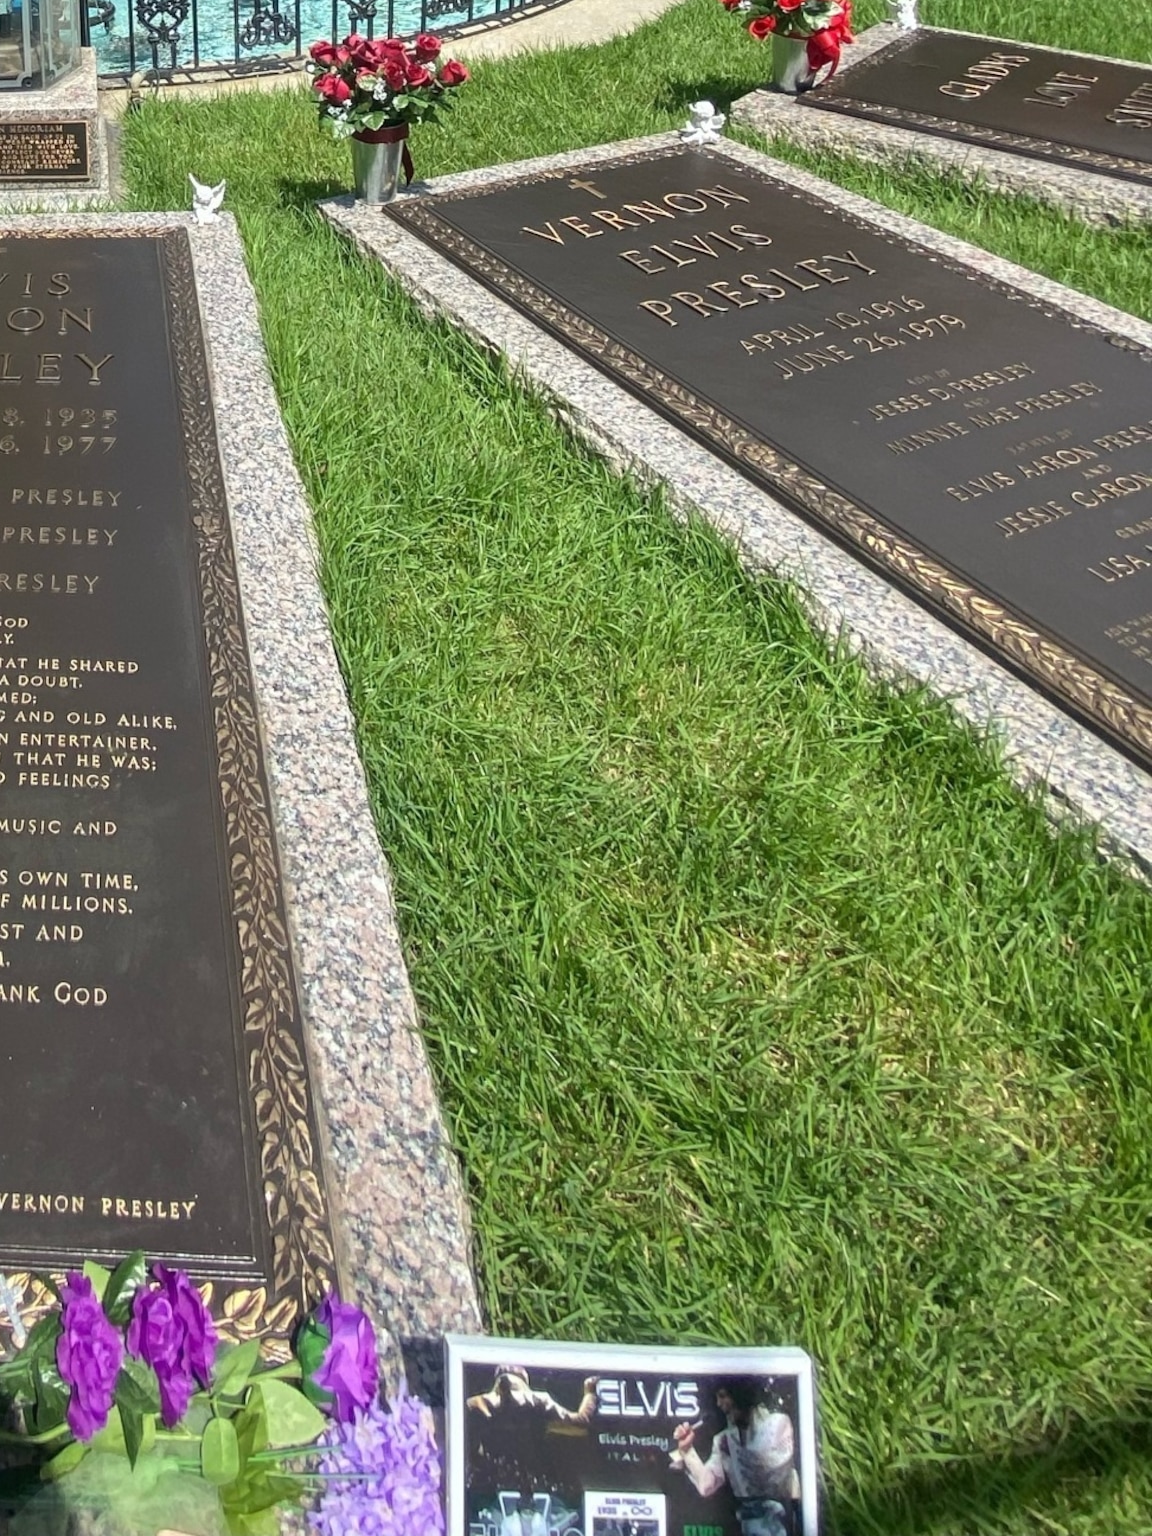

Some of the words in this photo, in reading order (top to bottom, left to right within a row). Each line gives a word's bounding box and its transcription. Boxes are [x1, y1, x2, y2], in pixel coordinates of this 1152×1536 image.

[939, 52, 1030, 100] GLADYS
[1023, 71, 1099, 108] LOVE
[521, 184, 750, 246] VERNON
[618, 224, 772, 275] ELVIS
[638, 250, 876, 327] PRESLEY
[740, 323, 824, 356] APRIL
[774, 344, 855, 381] JUNE
[43, 407, 118, 429] 1935
[867, 393, 932, 422] JESSE
[886, 420, 969, 457] MINNIE
[969, 405, 1020, 430] MAE
[1015, 380, 1103, 415] PRESLEY
[42, 434, 118, 456] 1977
[946, 471, 1015, 502] ELVIS
[1017, 444, 1098, 479] AARON
[11, 488, 122, 507] PRESLEY
[995, 500, 1072, 539] JESSIE
[2, 526, 118, 546] PRESLEY
[1087, 554, 1152, 583] LISA
[14, 711, 55, 723] AND
[66, 712, 107, 725] OLD
[14, 752, 66, 766] THAT
[77, 754, 101, 768] HE
[19, 772, 110, 789] FEELINGS
[73, 821, 117, 836] AND
[18, 871, 69, 887] OWN
[101, 1197, 196, 1221] PRESLEY
[595, 1377, 701, 1418] ELVIS
[598, 1433, 627, 1445] Elvis
[629, 1434, 669, 1452] Presley
